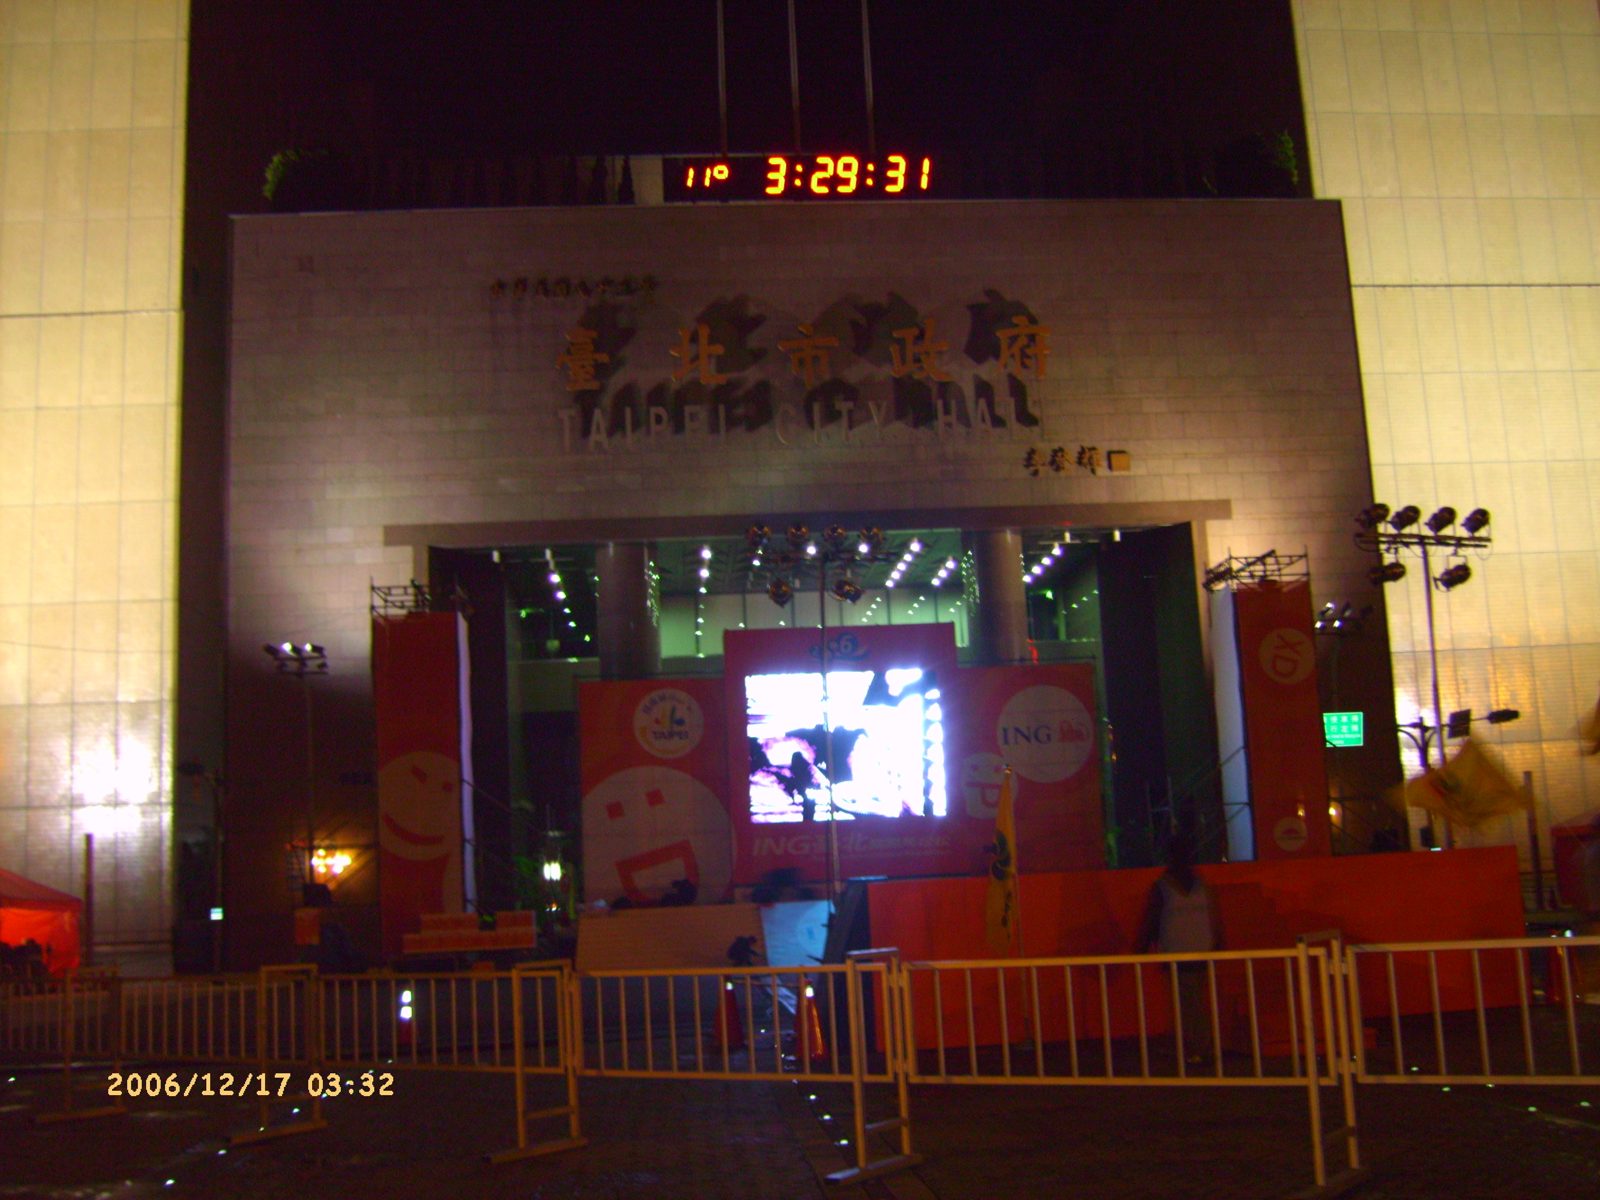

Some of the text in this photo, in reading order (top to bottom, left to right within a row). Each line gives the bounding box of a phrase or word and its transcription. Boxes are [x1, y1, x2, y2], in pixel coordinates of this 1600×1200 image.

[764, 155, 932, 195] 3:29:31
[556, 314, 1050, 392] 臺北市政府
[557, 404, 728, 451] TAIPEI
[776, 400, 889, 447] CITY
[1002, 724, 1052, 746] ING
